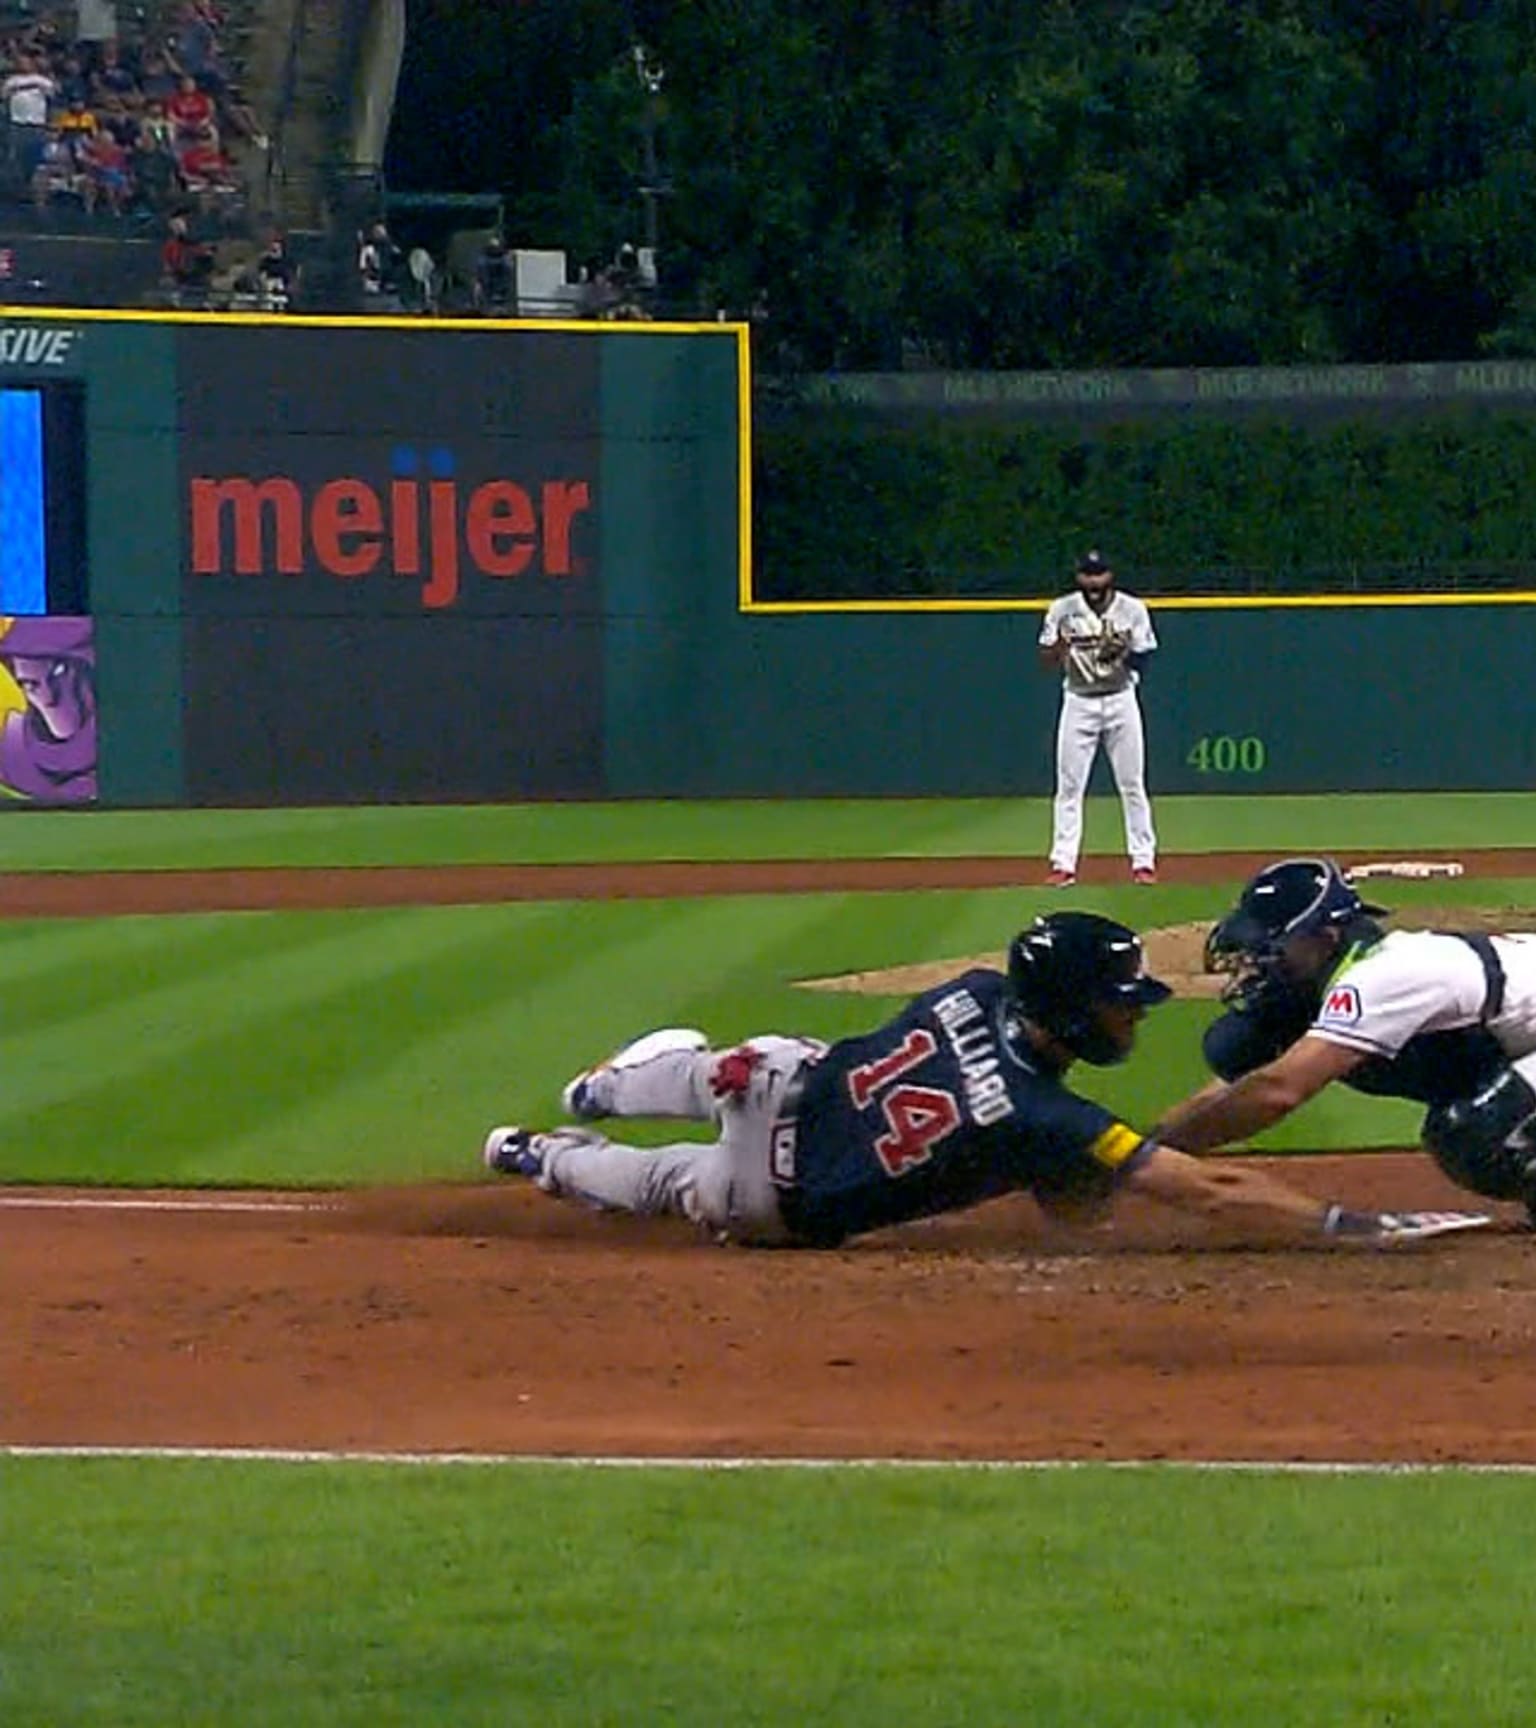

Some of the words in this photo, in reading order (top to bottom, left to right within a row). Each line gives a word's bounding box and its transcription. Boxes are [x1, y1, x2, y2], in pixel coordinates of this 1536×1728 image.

[191, 446, 591, 609] meijer
[1186, 735, 1266, 774] 400
[846, 1029, 961, 1178] 14
